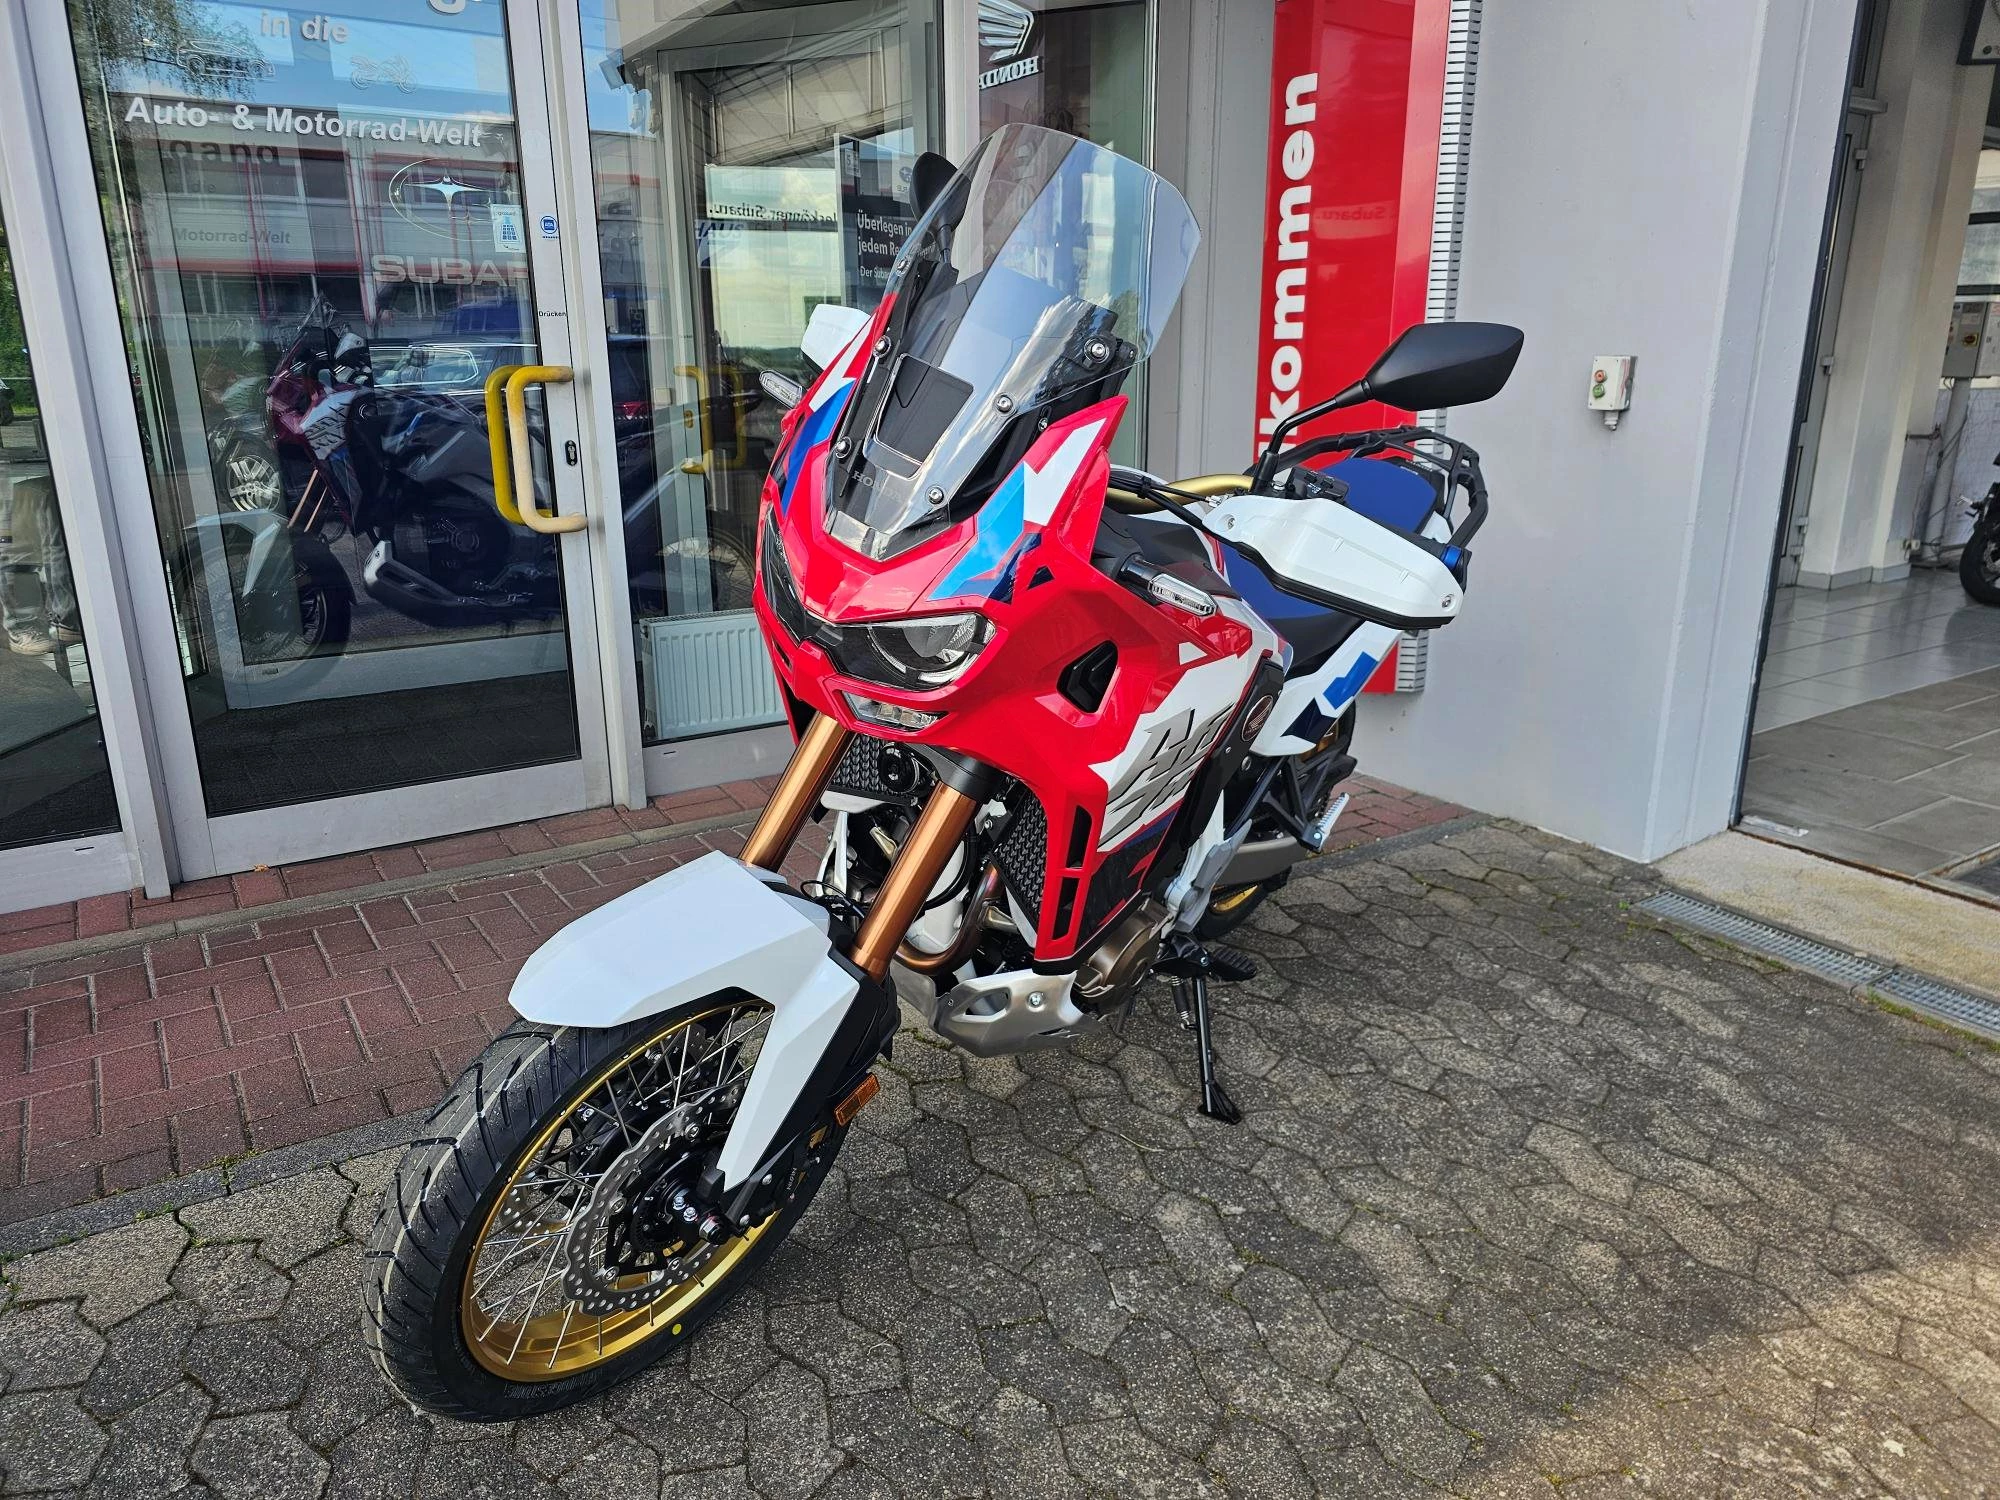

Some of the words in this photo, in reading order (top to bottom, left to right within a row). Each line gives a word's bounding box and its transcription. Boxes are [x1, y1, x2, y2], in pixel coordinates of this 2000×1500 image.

[260, 9, 290, 36] in
[302, 16, 350, 43] die
[125, 97, 219, 127] Auto-
[232, 104, 254, 130] &
[267, 107, 482, 146] Motorrad-Welt
[857, 209, 904, 238] Überlegen
[858, 236, 888, 255] jedem
[860, 265, 873, 277] Der
